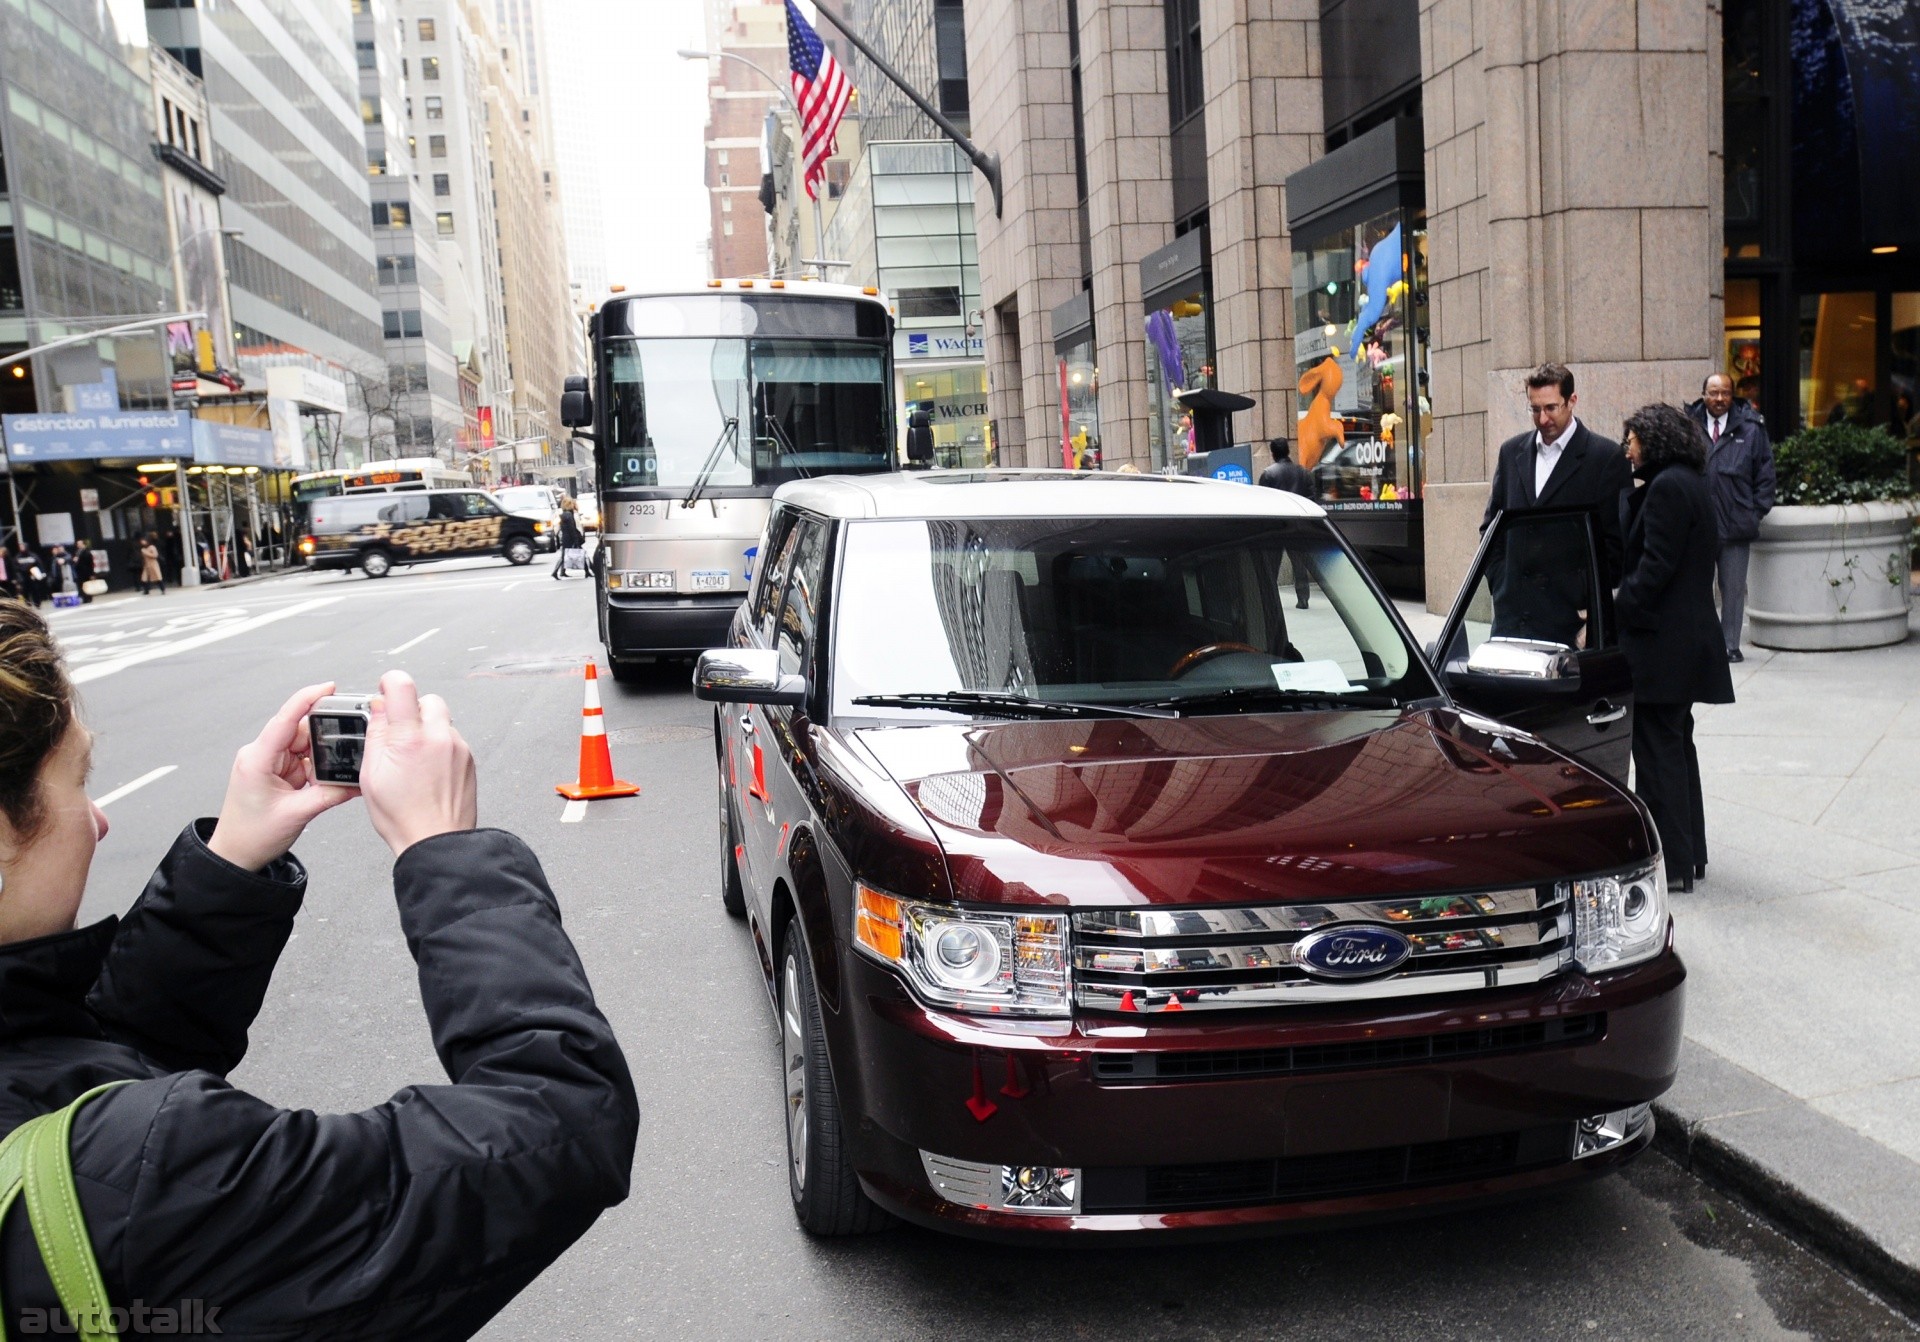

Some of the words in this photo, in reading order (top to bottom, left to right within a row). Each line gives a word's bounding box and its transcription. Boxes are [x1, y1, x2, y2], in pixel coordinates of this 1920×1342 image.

[935, 337, 984, 349] WACH
[13, 417, 96, 432] distinction
[99, 415, 179, 429] illuminated
[1355, 435, 1388, 464] color
[629, 504, 655, 515] 2923
[390, 515, 504, 546] GOLDEN
[407, 533, 500, 556] TOUCH
[1325, 937, 1388, 966] Ford
